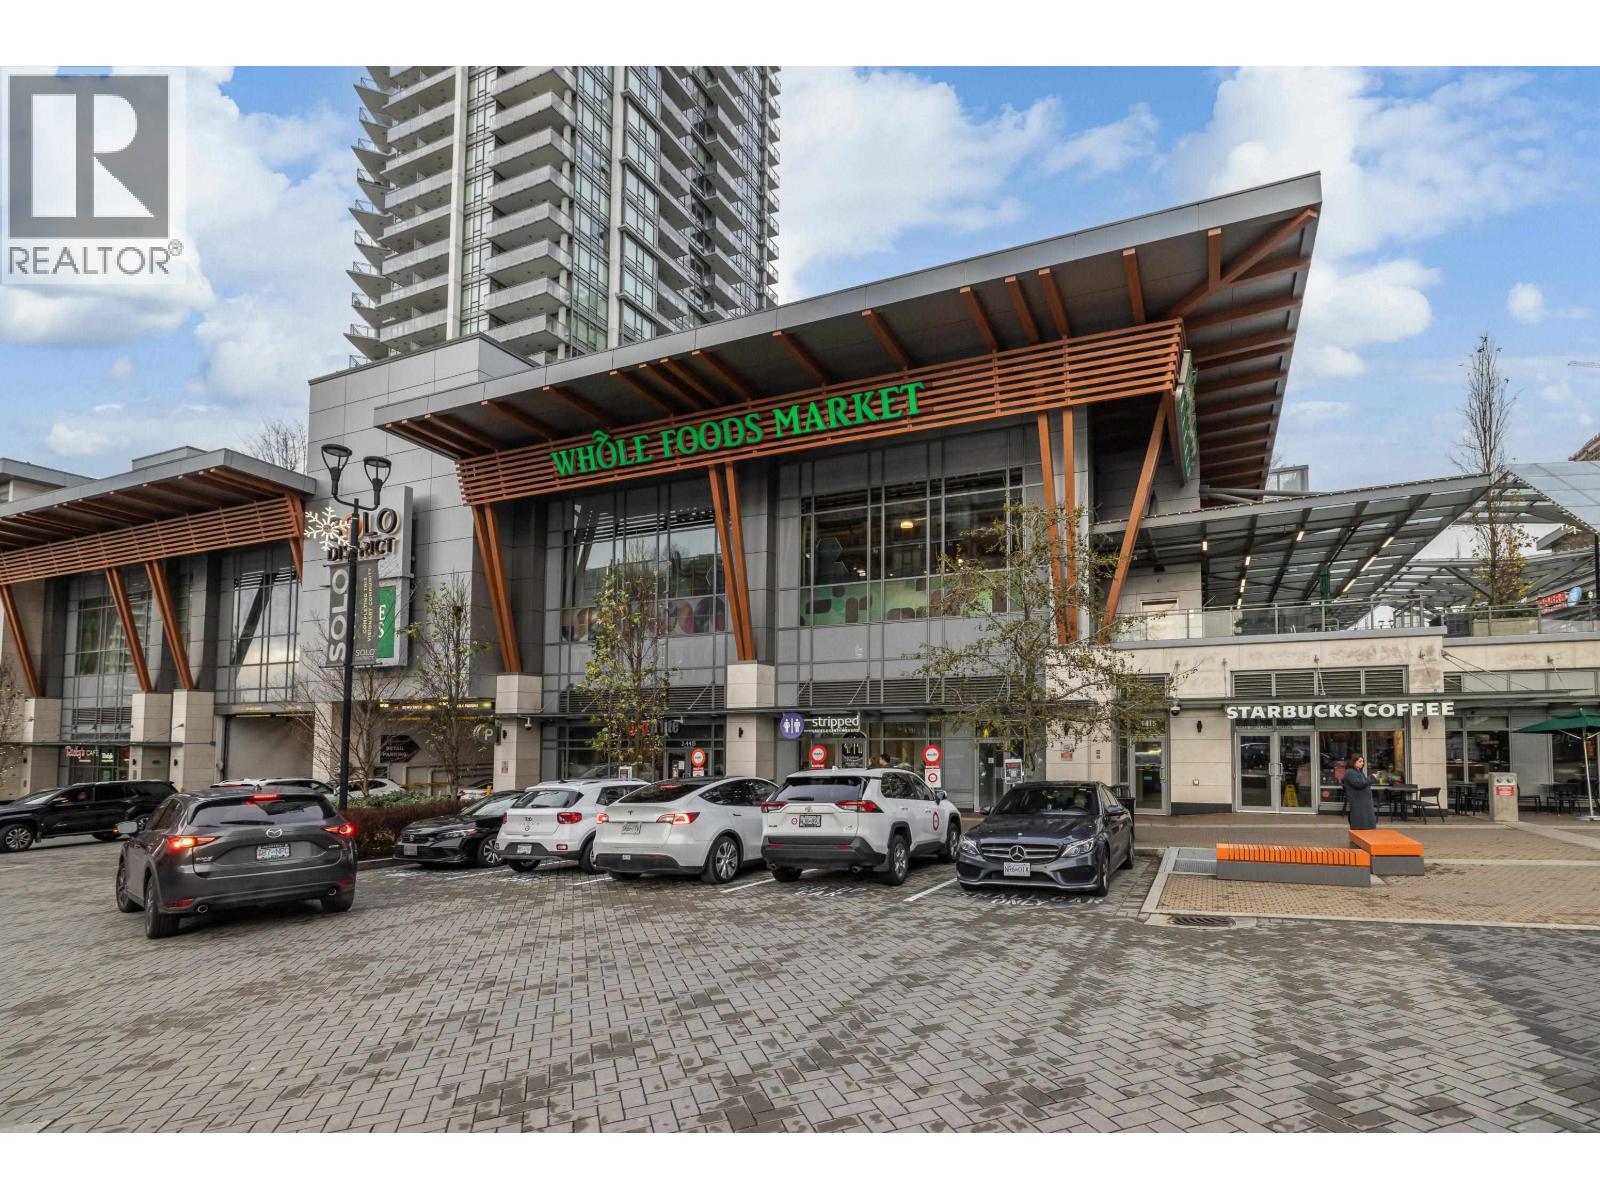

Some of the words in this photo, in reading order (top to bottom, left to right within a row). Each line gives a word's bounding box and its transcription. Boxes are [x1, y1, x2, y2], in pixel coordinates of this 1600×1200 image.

[660, 413, 763, 458] FOODS
[772, 382, 925, 438] MARKET
[329, 569, 349, 662] SOLO
[812, 714, 860, 732] stripped
[1226, 703, 1358, 719] STARBUCKS
[1363, 702, 1455, 718] COFFEE
